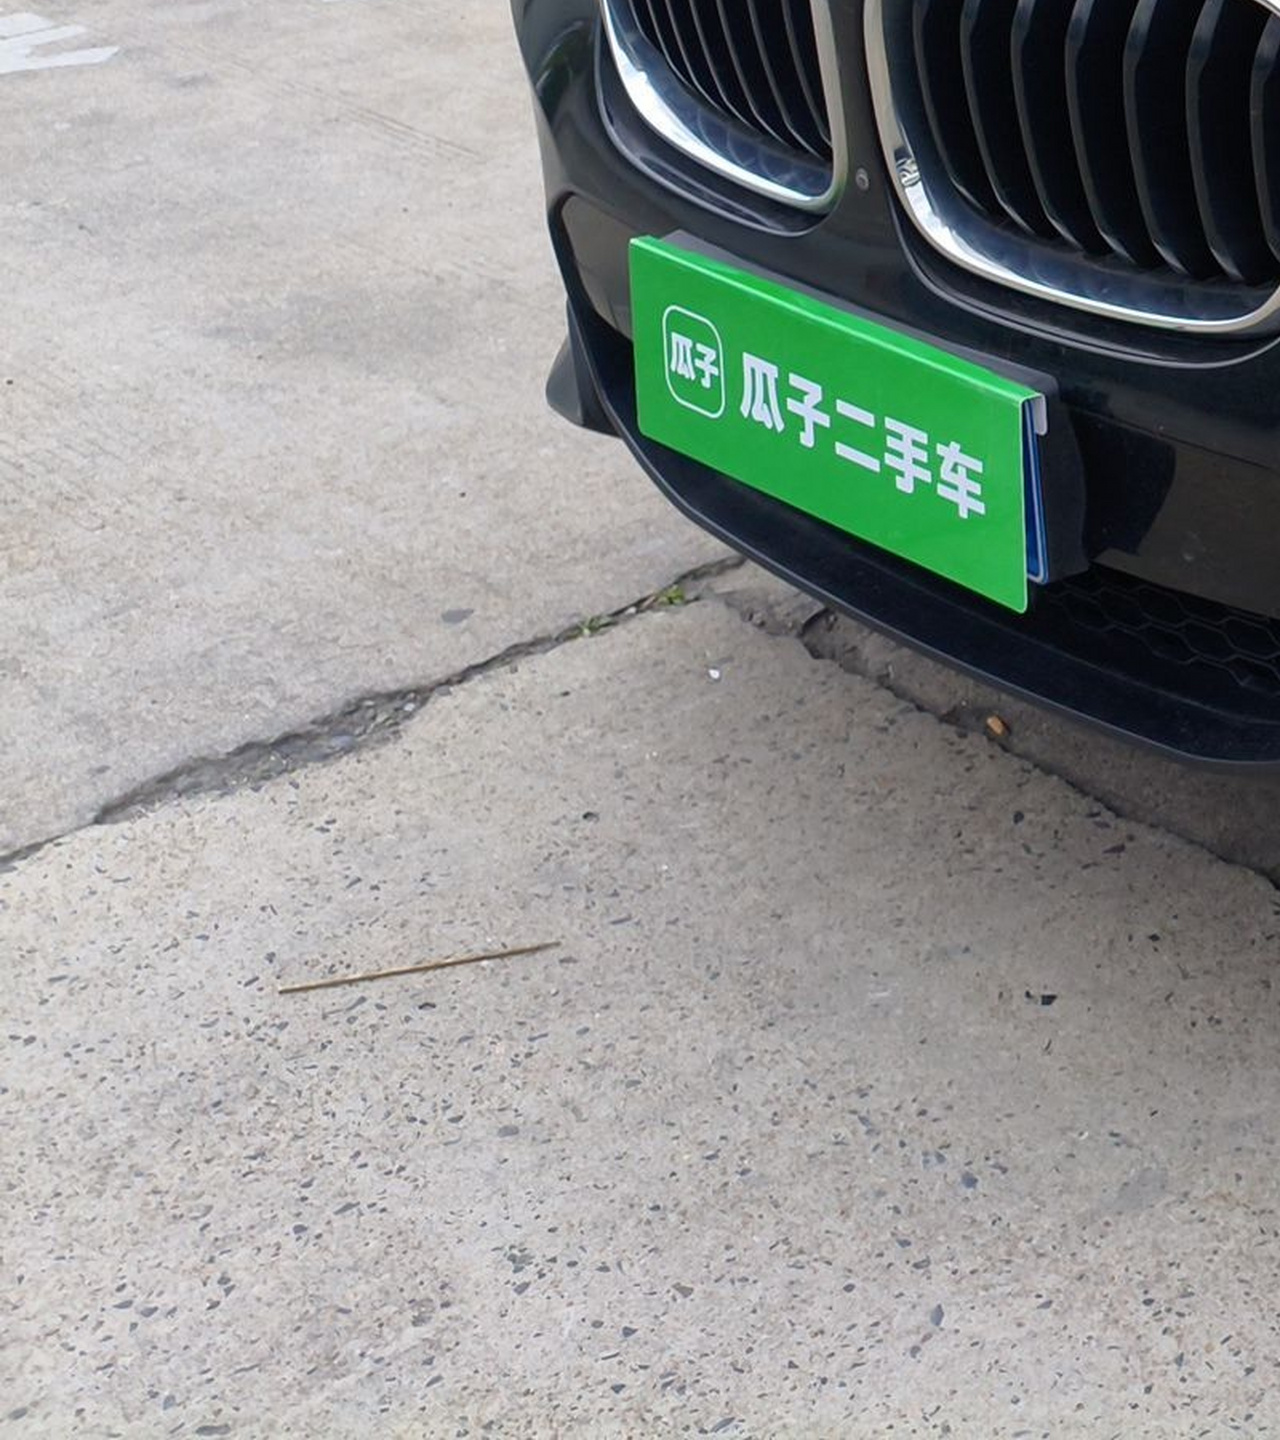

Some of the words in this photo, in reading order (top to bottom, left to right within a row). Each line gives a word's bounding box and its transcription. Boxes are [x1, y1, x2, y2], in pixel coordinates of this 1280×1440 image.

[670, 331, 720, 389] 瓜子
[739, 351, 987, 520] 瓜子二手车
